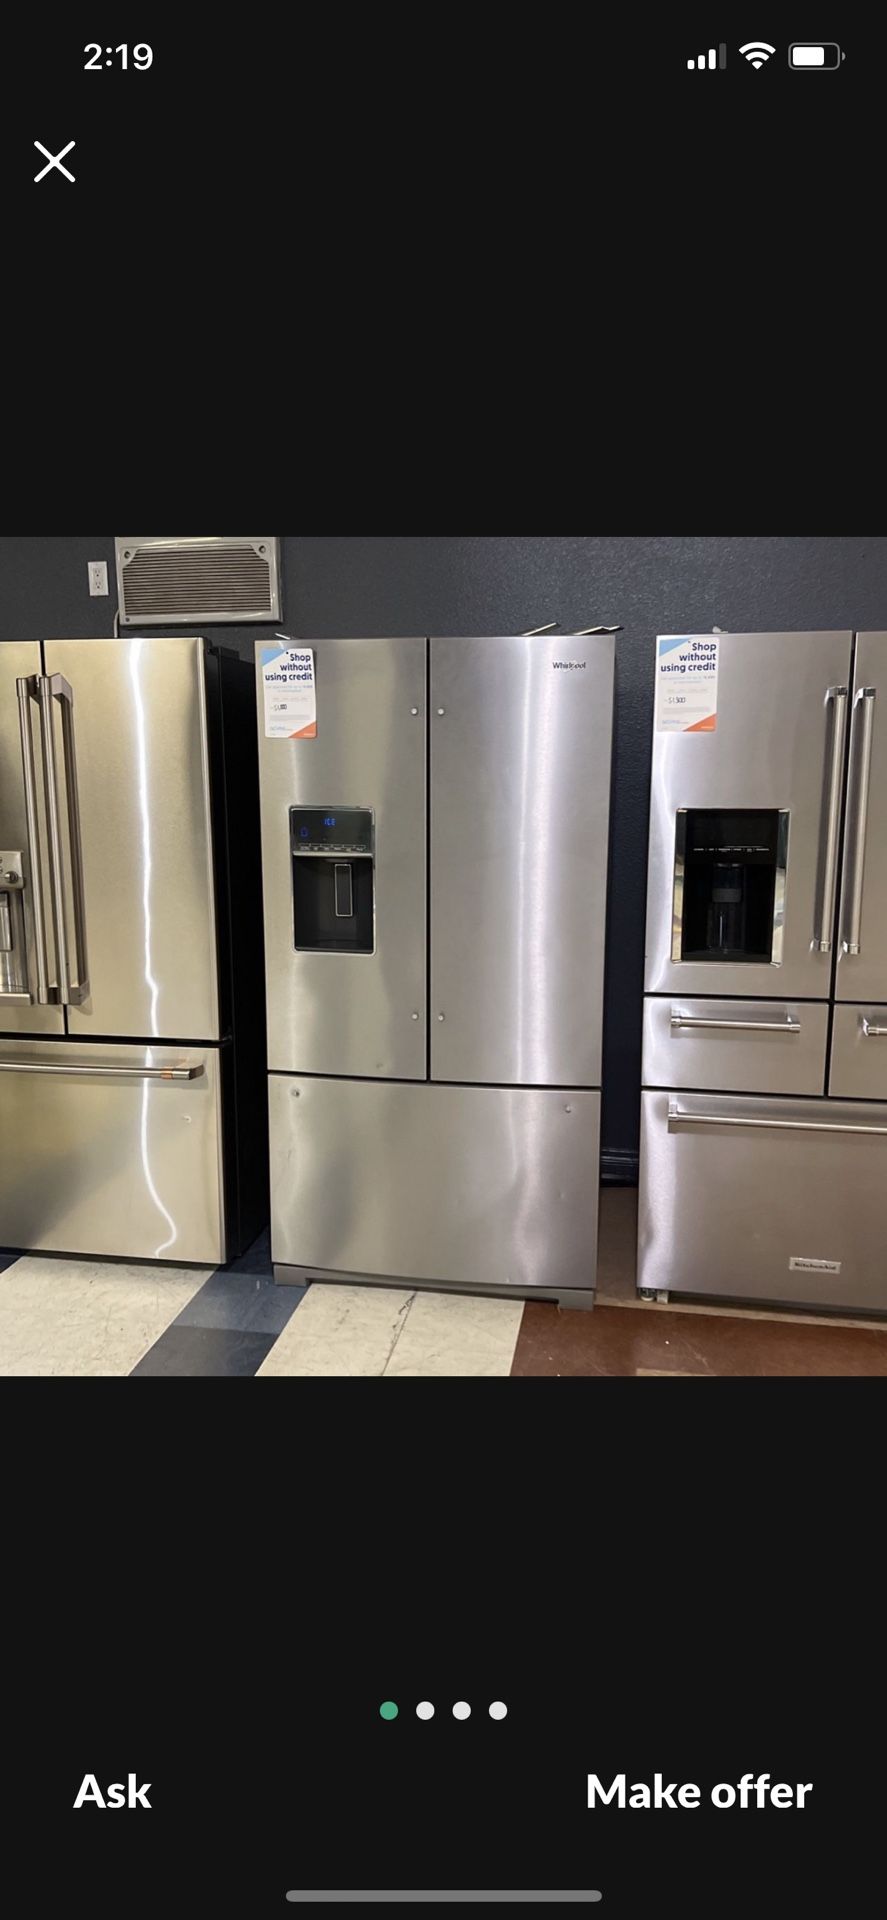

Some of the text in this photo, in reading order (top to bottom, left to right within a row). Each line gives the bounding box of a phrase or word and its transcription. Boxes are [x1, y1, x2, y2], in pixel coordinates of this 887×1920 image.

[692, 643, 716, 652] Shop
[290, 653, 311, 662] Shop
[679, 652, 716, 661] without
[280, 663, 312, 671] without
[552, 661, 586, 670] Whirlpool
[660, 662, 716, 673] using credit
[265, 672, 313, 682] using credit
